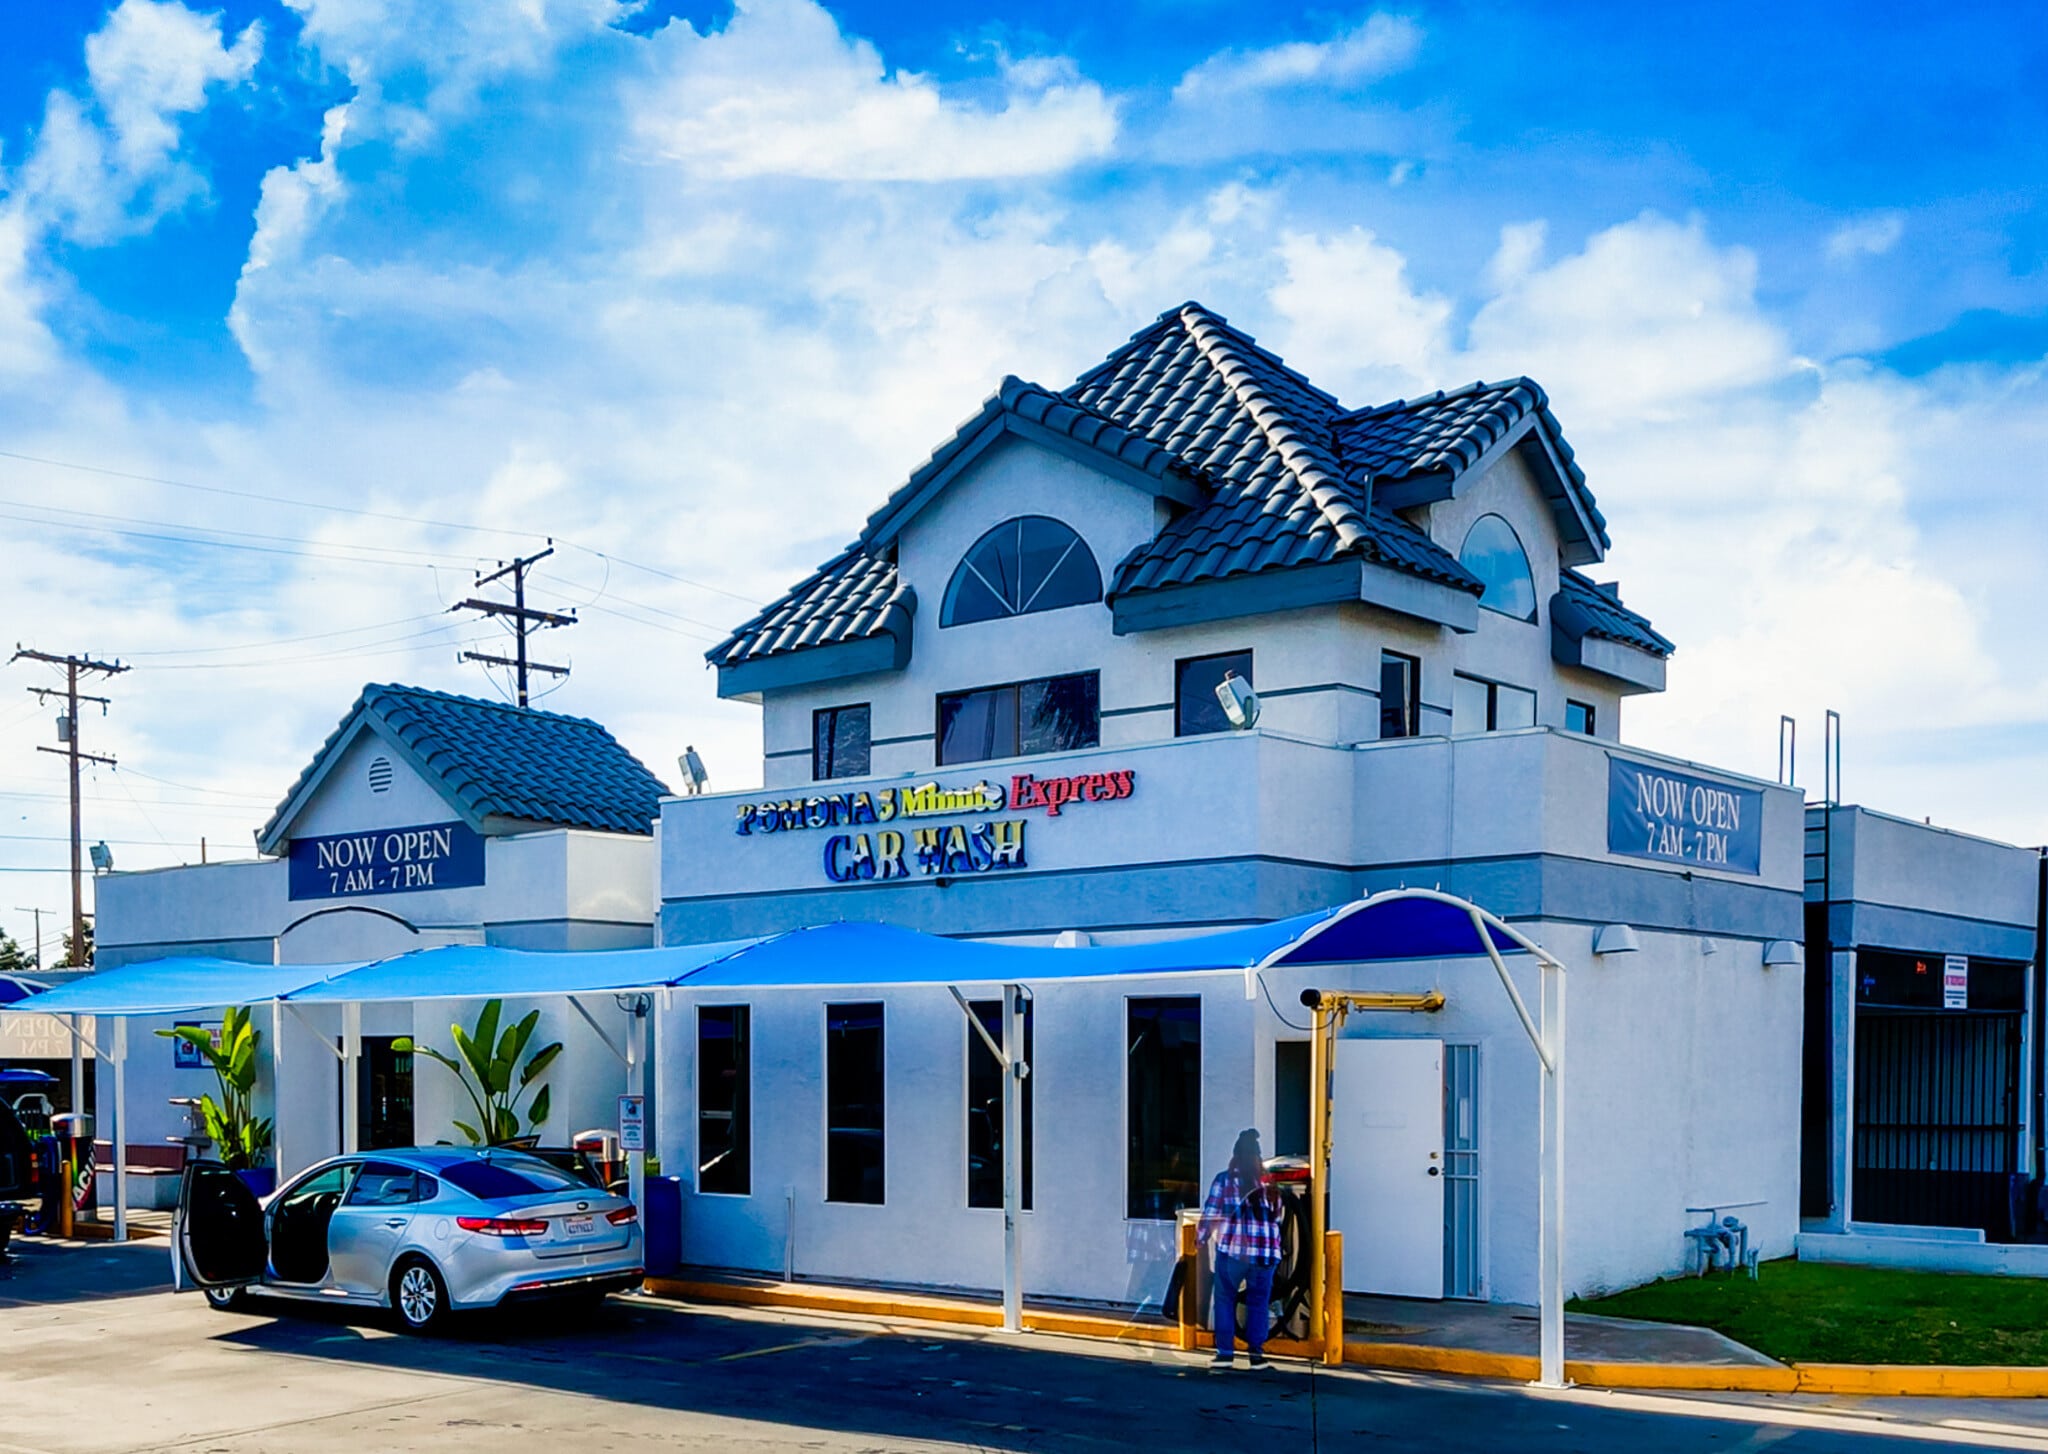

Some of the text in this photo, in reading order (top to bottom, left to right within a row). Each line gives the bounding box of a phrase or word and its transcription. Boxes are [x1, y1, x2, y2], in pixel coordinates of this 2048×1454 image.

[900, 780, 1005, 817] Minute
[1008, 769, 1134, 816] Express
[1636, 772, 1741, 832] NOW OPEN
[317, 827, 452, 870] NOW OPEN
[823, 819, 1028, 882] CAR WASH
[1647, 821, 1656, 854] 7
[1658, 823, 1684, 858] AM
[1695, 830, 1704, 861] 7
[1705, 831, 1728, 865] PM
[330, 872, 339, 894] 7
[343, 868, 374, 893] AM
[390, 866, 400, 889] 7
[404, 862, 434, 888] PM
